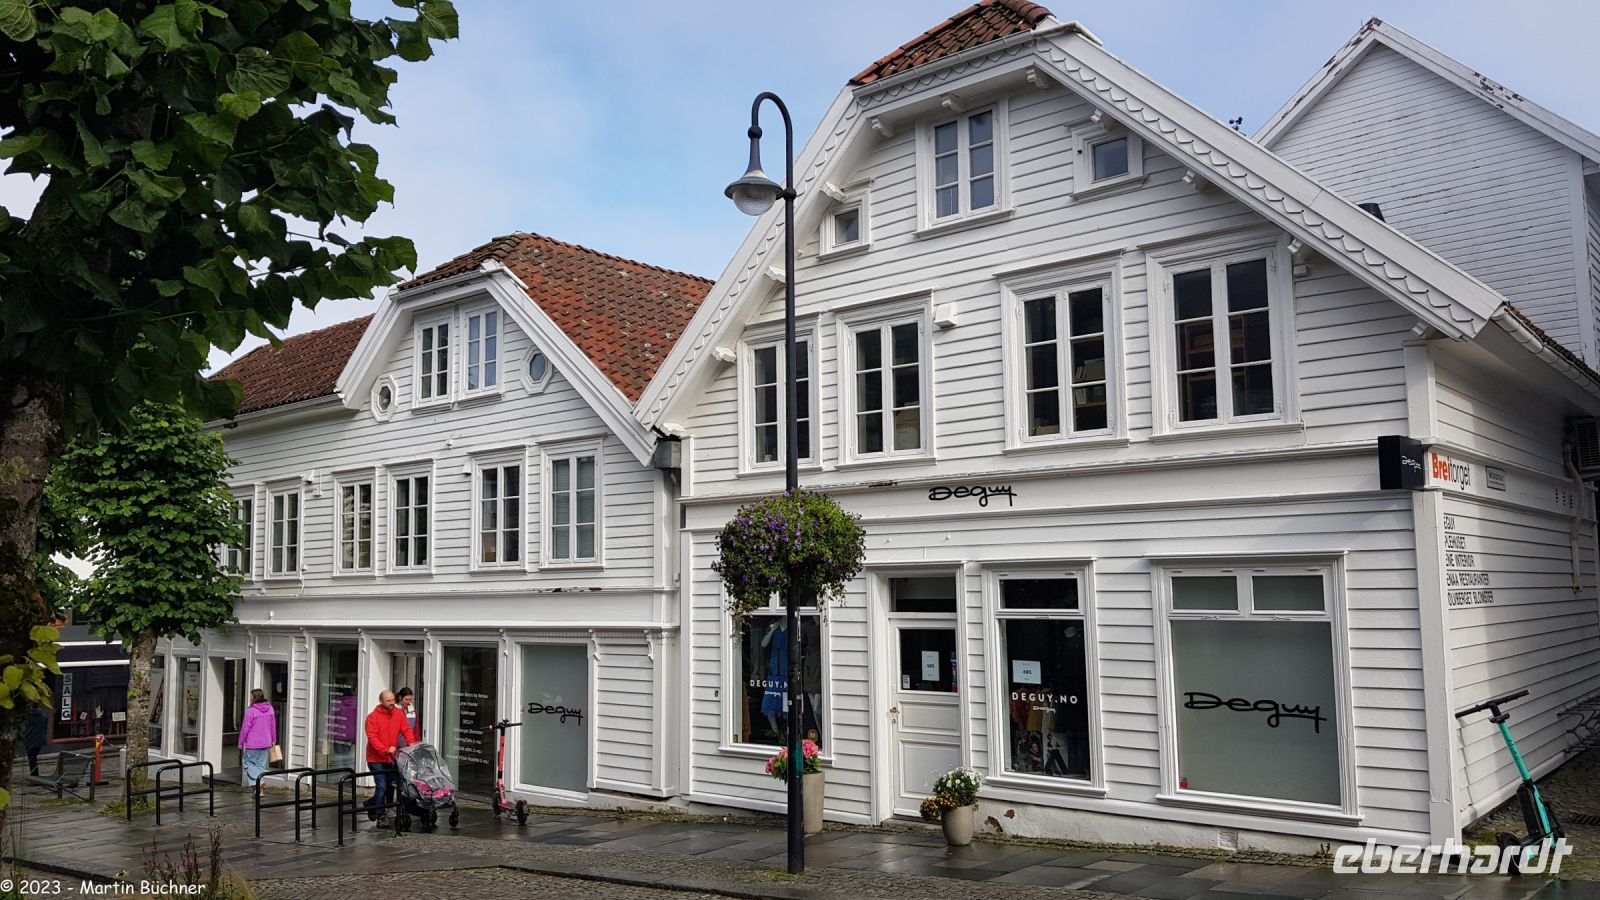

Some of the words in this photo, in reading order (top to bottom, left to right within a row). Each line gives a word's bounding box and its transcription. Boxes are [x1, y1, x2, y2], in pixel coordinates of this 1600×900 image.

[1432, 453, 1471, 490] Breitorget
[928, 485, 1018, 507] Deguy
[1443, 516, 1455, 530] EGUY
[1444, 535, 1466, 550] PLEHUSET
[1446, 573, 1459, 586] ENAA
[750, 679, 788, 688] DEGUY.N
[62, 674, 72, 719] SALG
[1012, 692, 1078, 704] DEGUY.NO
[528, 703, 584, 726] Deguy
[1184, 692, 1327, 734] Deguy
